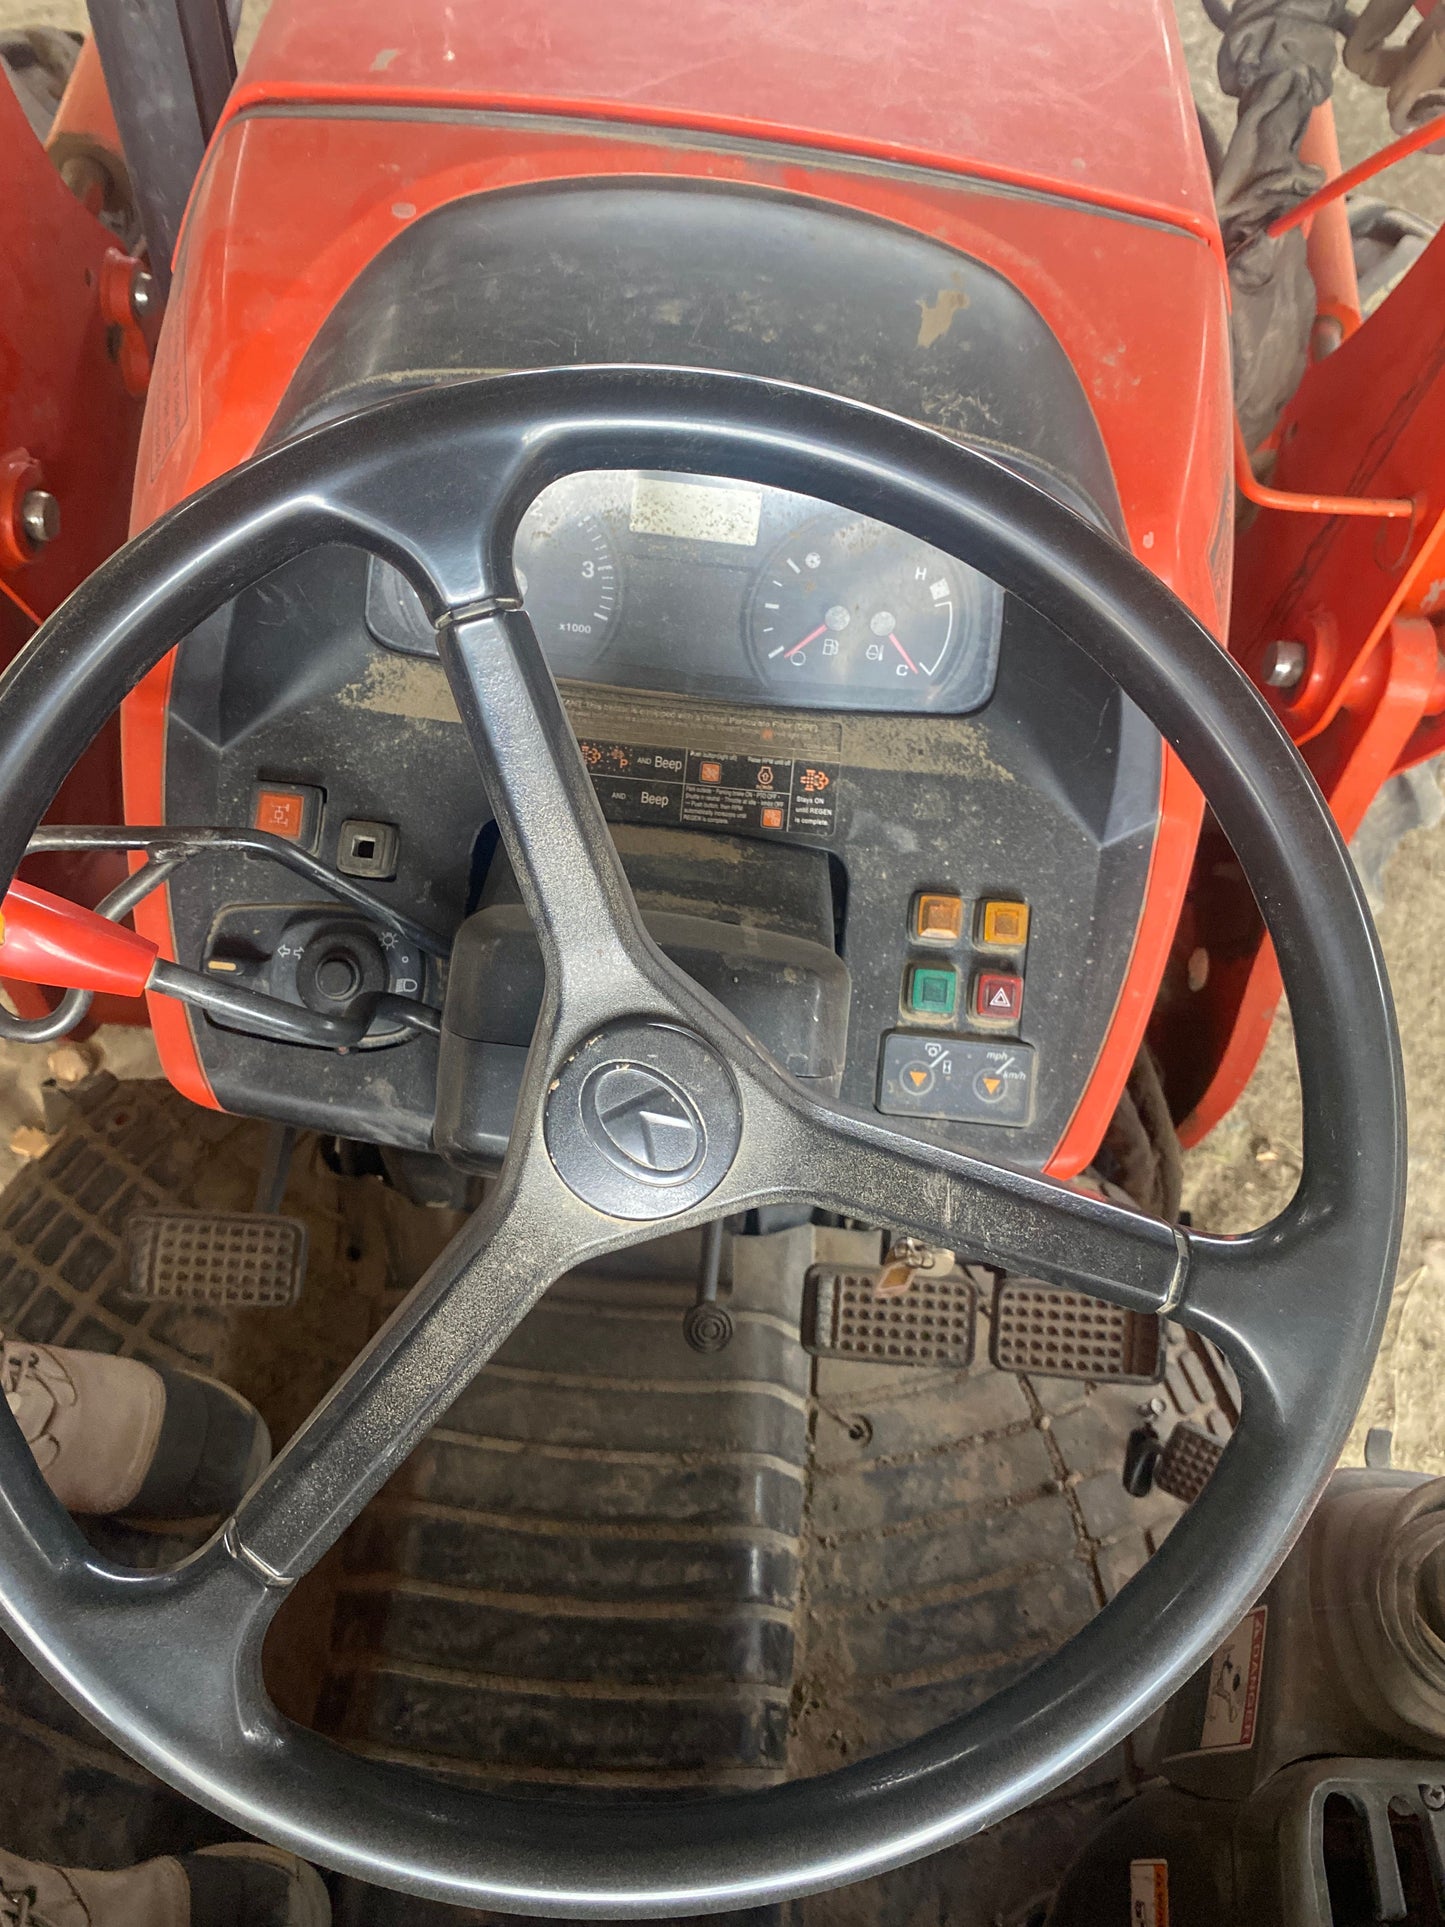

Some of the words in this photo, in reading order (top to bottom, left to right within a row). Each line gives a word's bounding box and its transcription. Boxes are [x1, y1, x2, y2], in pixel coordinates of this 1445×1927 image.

[581, 560, 595, 578] 3
[914, 566, 927, 581] H
[558, 622, 592, 634] x1000
[895, 663, 909, 677] C
[637, 757, 652, 765] AND
[654, 755, 683, 773] Beep
[611, 792, 627, 800] AND
[640, 791, 669, 809] Beep
[986, 1051, 1008, 1062] mph
[1002, 1071, 1026, 1081] km/h
[1242, 1643, 1262, 1740] DANGER
